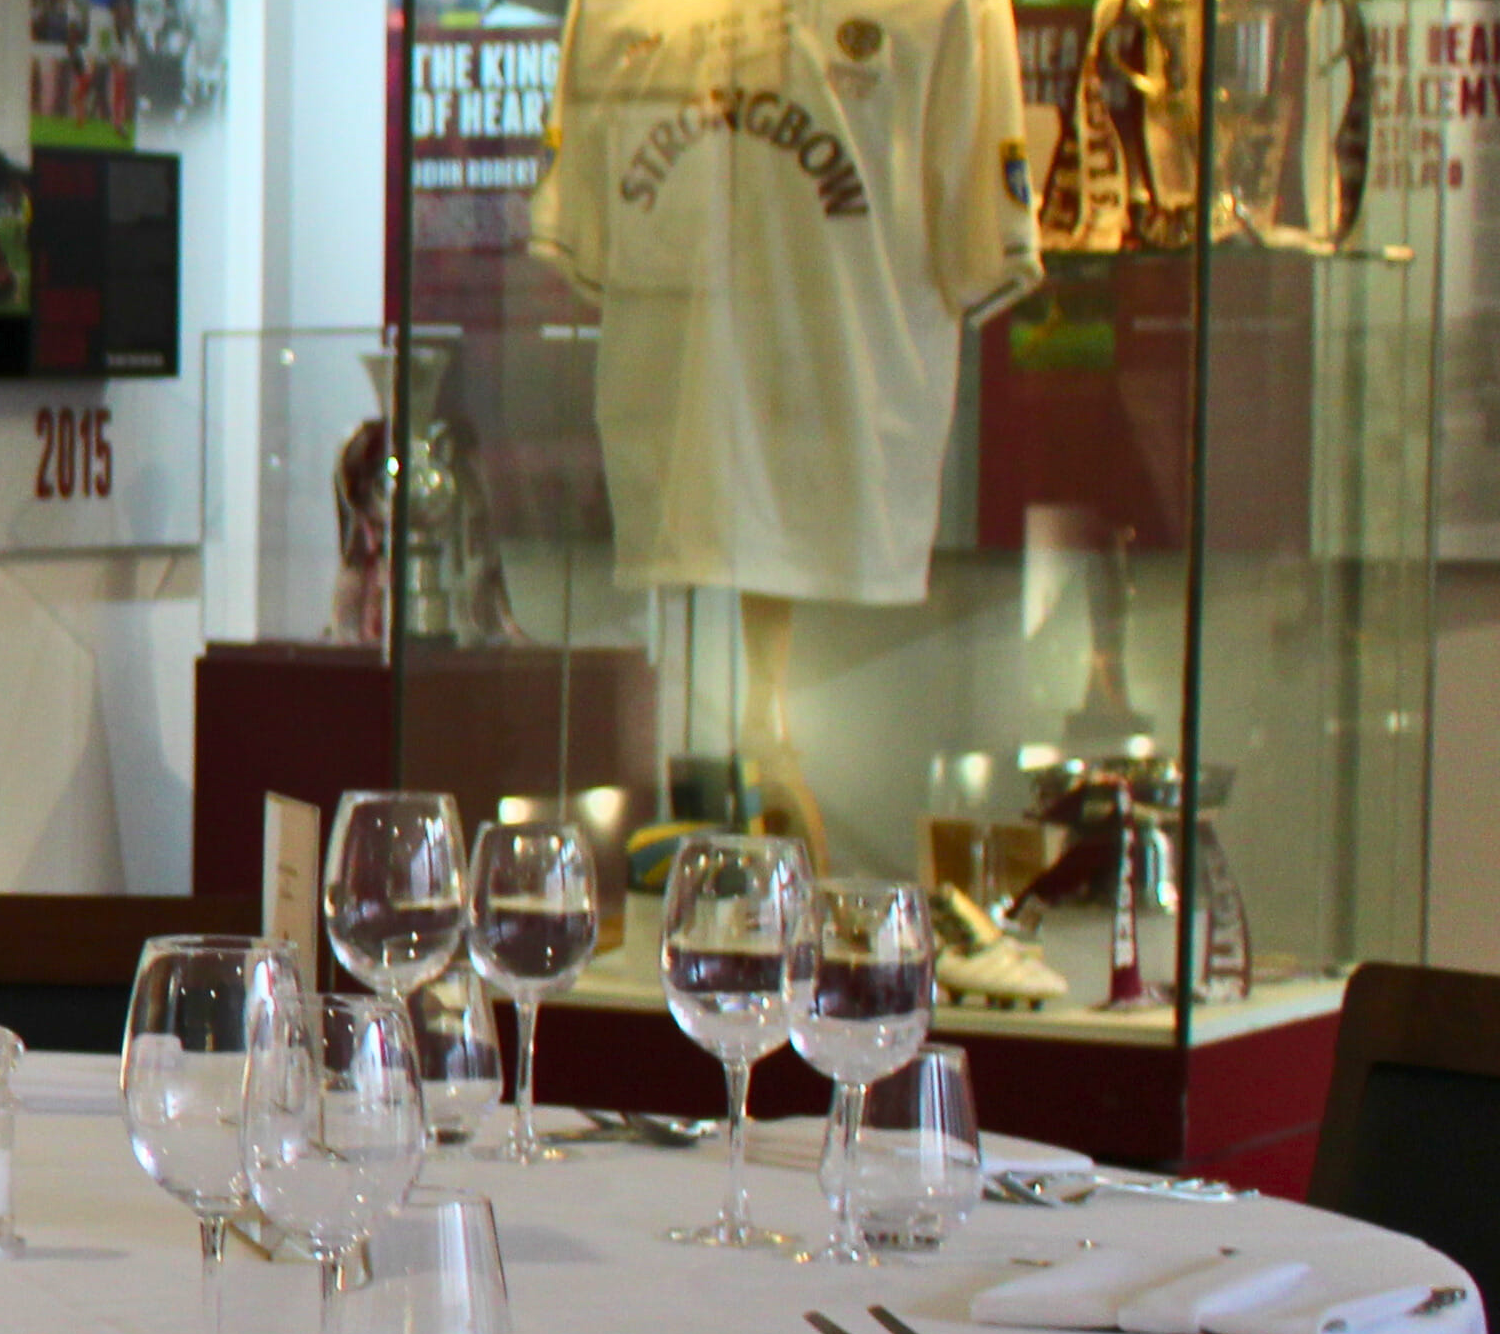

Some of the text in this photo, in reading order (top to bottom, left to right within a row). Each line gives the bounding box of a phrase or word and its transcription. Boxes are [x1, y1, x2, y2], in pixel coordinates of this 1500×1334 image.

[411, 41, 562, 90] THE KING
[411, 91, 453, 138] OF
[619, 85, 869, 219] STRONGBOW
[35, 406, 112, 500] 2015
